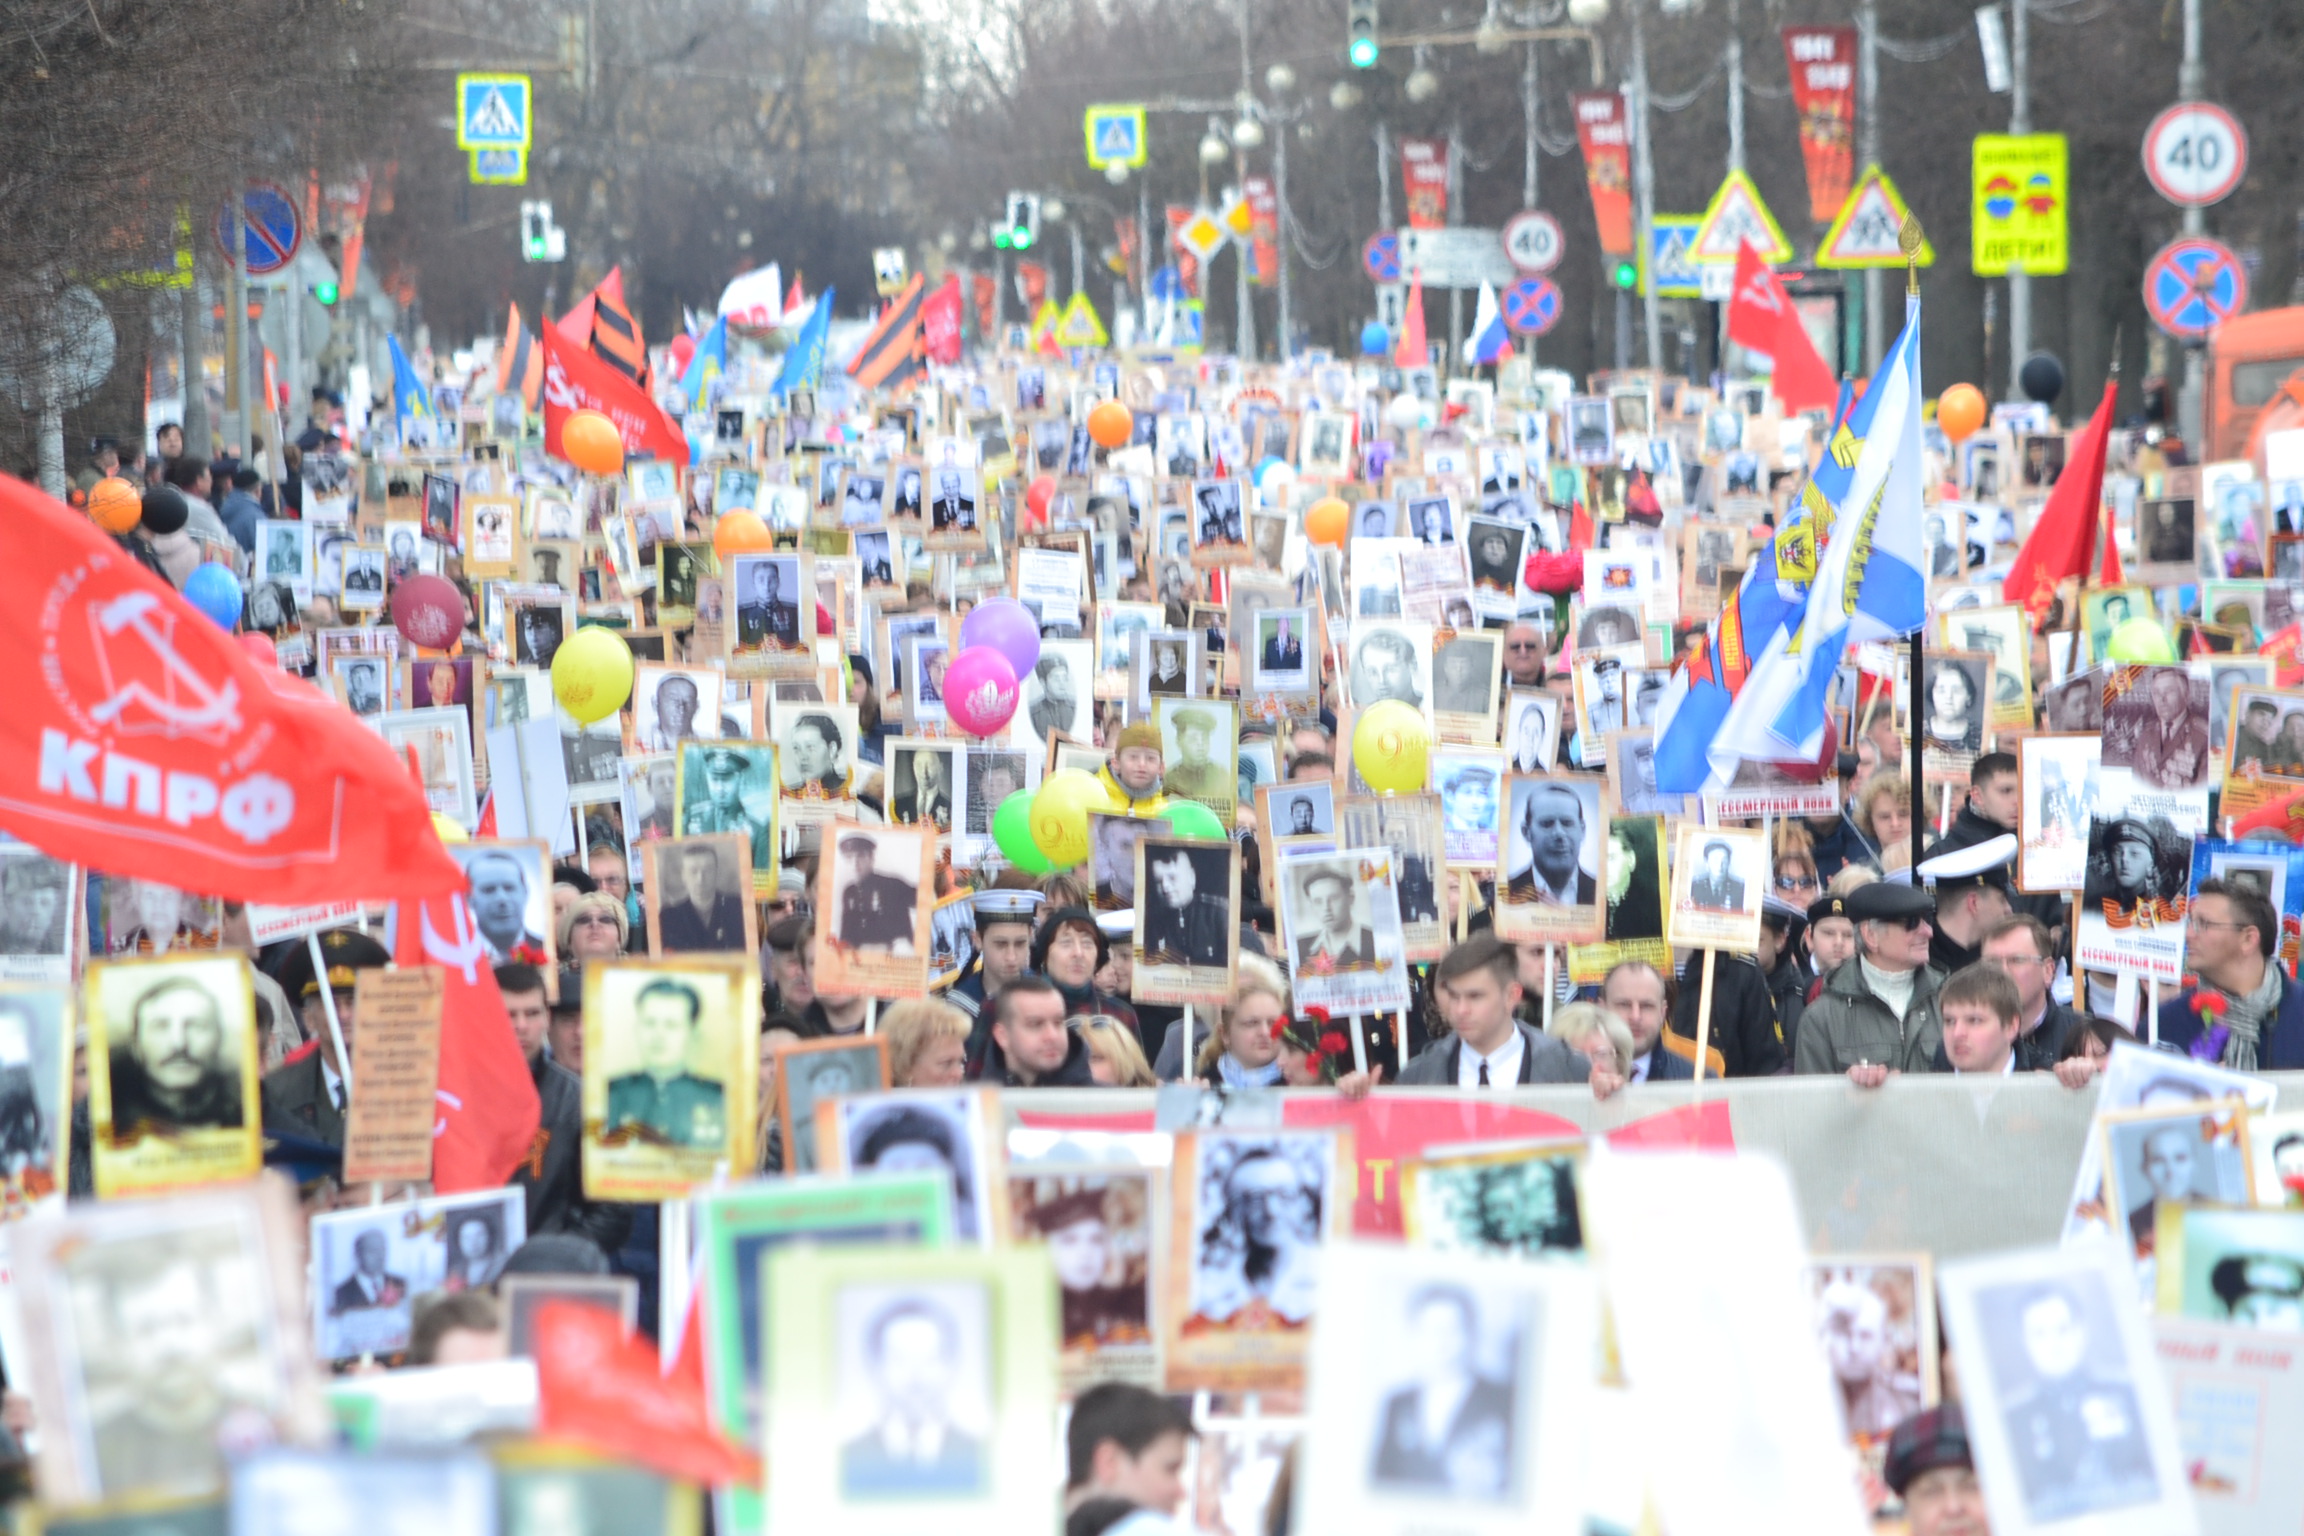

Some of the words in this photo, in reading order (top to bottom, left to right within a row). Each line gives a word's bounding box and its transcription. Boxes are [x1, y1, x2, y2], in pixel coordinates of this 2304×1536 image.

[2167, 133, 2221, 171] 40
[1515, 229, 1550, 252] 40
[1377, 728, 1402, 770] 9
[38, 726, 295, 845] КПРФ
[2082, 946, 2149, 968] БЕССМЕРТНЫЙ
